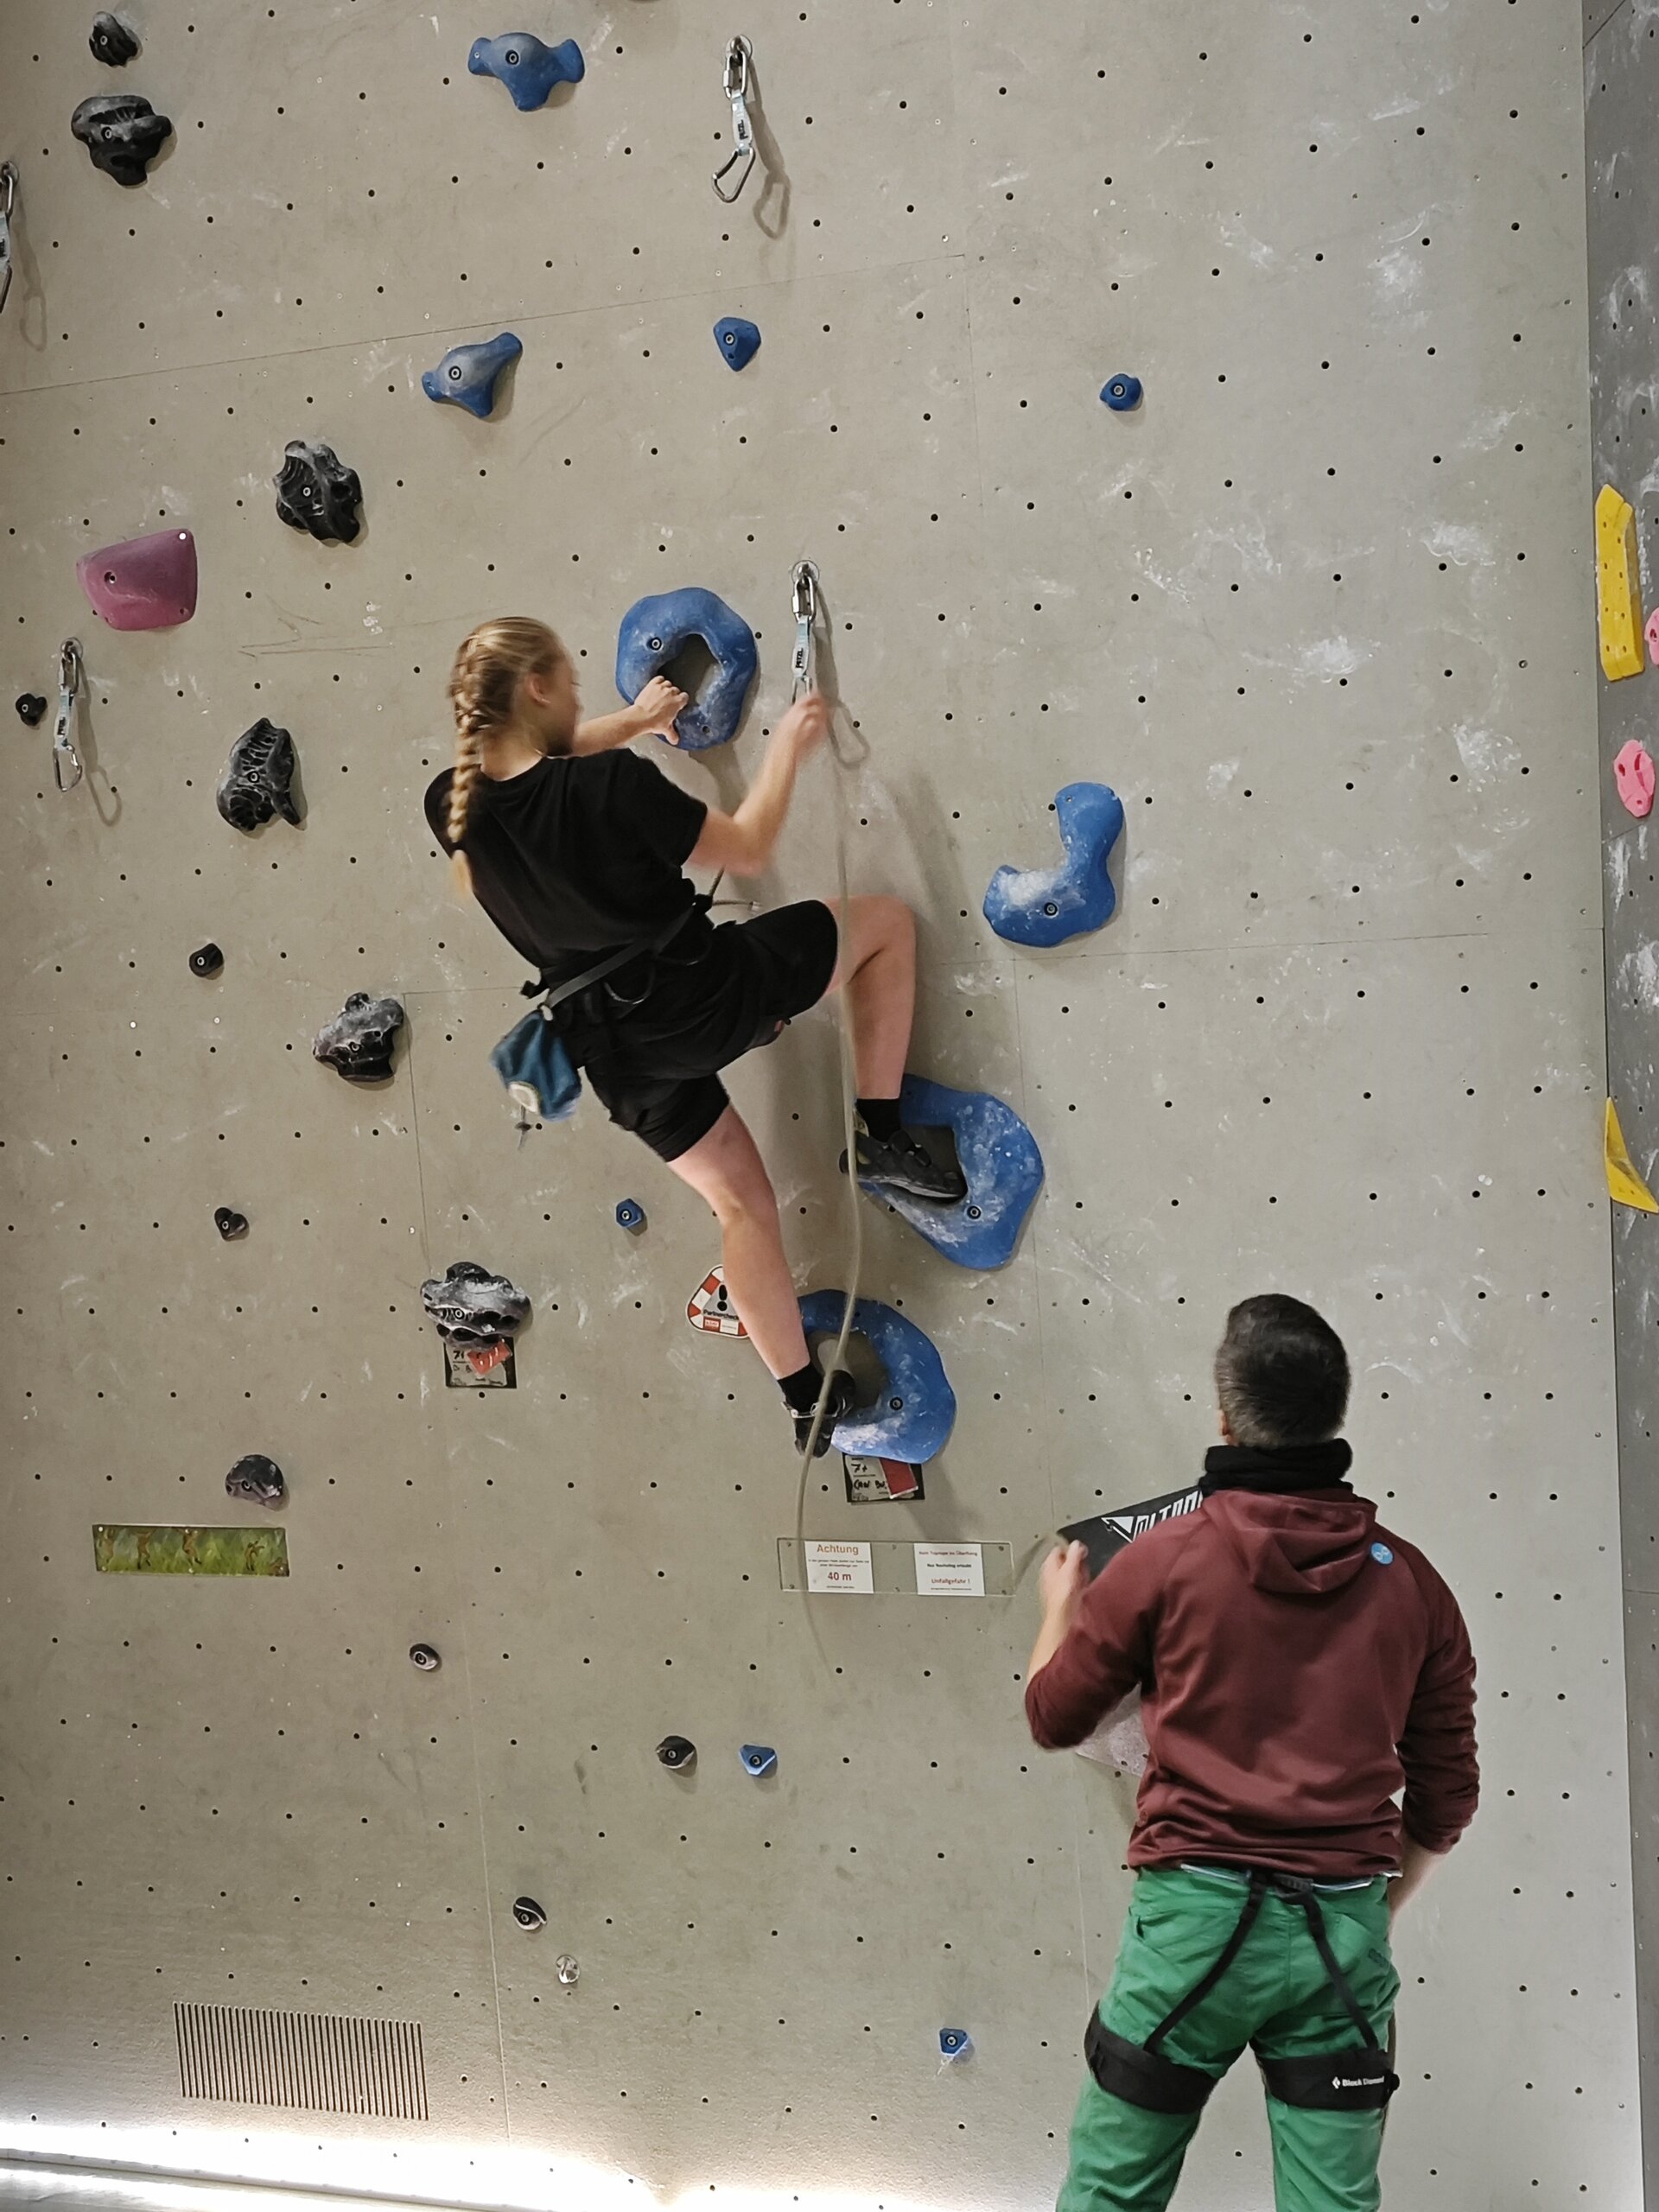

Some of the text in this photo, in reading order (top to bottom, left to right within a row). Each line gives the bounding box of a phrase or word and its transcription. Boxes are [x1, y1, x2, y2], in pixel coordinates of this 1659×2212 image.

[817, 1544, 859, 1555] Achtung
[828, 1572, 840, 1581] 40
[1342, 2078, 1363, 2087] Black
